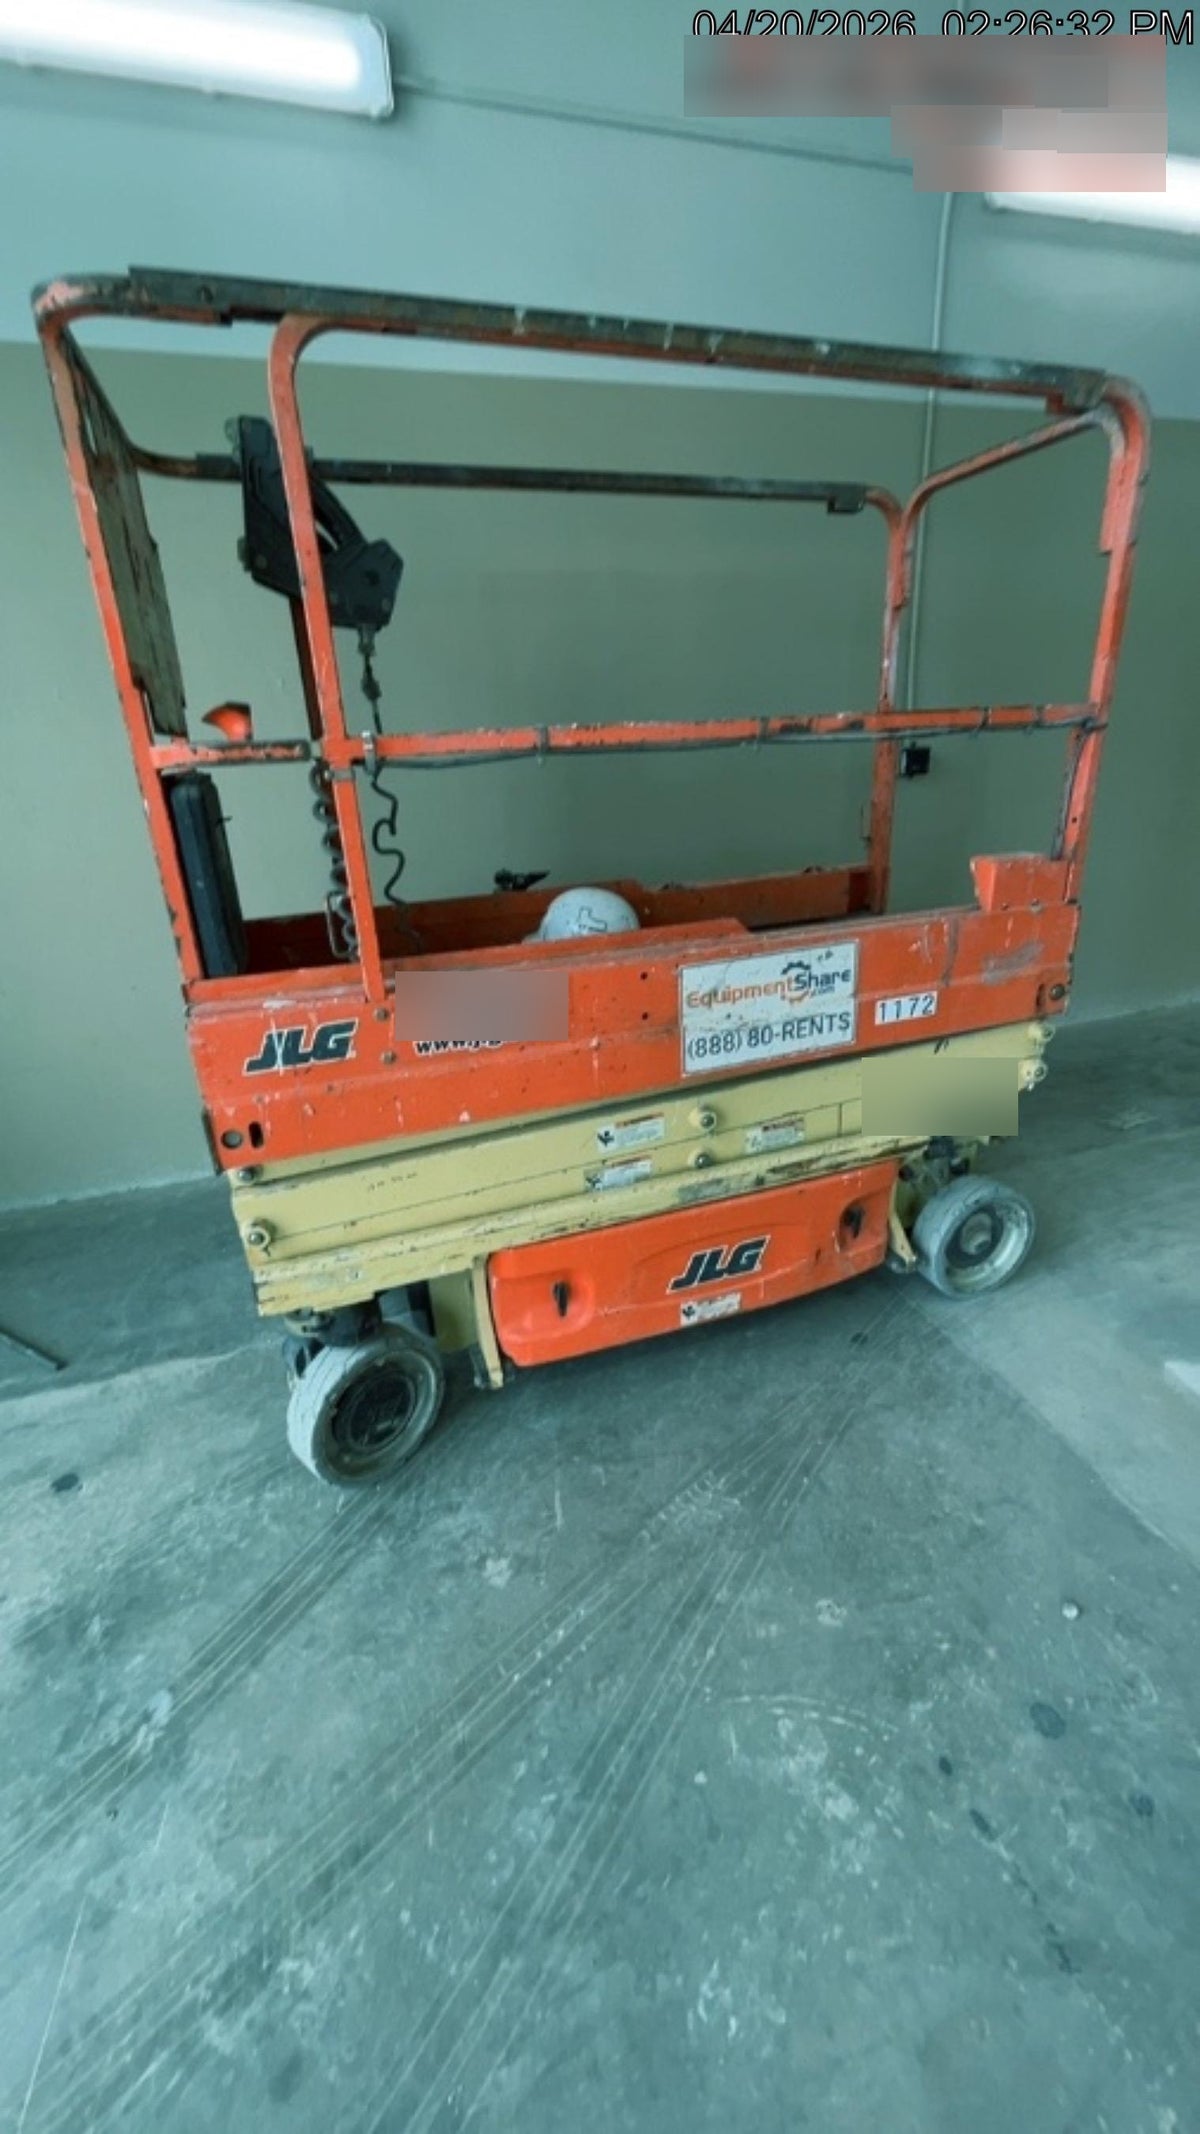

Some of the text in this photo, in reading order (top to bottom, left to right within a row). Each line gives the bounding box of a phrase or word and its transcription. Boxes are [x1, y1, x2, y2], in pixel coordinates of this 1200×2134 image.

[878, 996, 935, 1022] 1172
[245, 1020, 357, 1073] JLG
[687, 1011, 851, 1060] (888) 80-RENTS
[668, 1237, 769, 1292] JLG
